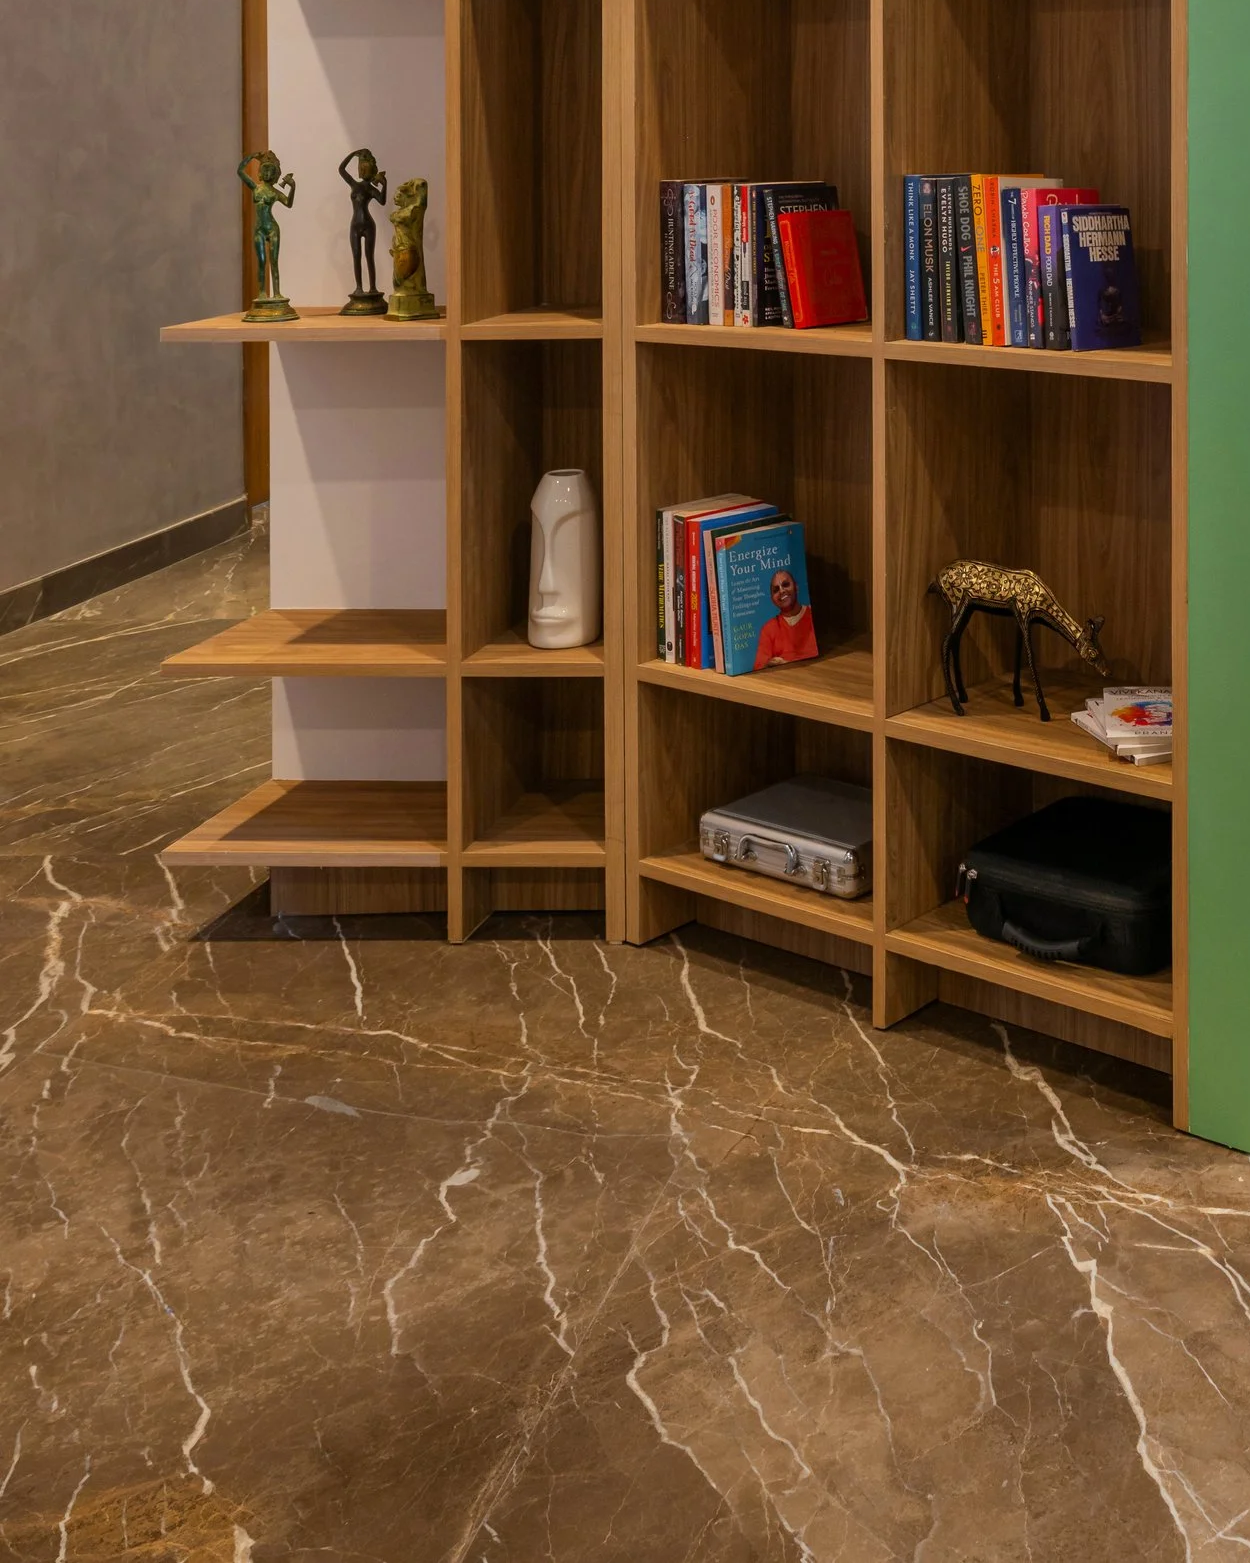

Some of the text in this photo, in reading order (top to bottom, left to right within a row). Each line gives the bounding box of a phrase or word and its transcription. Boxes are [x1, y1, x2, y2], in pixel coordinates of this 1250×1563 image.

[766, 196, 779, 244] STEPHEN HAWKING
[958, 186, 970, 241] SHOE DOG
[972, 185, 985, 252] ZERO ONE
[1043, 215, 1051, 234] RICH
[1072, 215, 1130, 231] SIDDHARTHA
[923, 204, 933, 272] ELON MUSK
[1044, 236, 1052, 255] DAD
[1079, 231, 1126, 247] HERMANN
[1011, 243, 1019, 274] EFFECTIVE
[1045, 256, 1053, 272] POOR
[1089, 246, 1120, 262] HESSE
[962, 256, 976, 317] PHIL KNIGHT
[994, 286, 999, 298] AM
[1012, 275, 1020, 298] PEOPLE
[1062, 234, 1076, 328] SIDDHARTHA HERMANN HESSE
[729, 545, 778, 563] Energize
[730, 554, 791, 576] Your Mind
